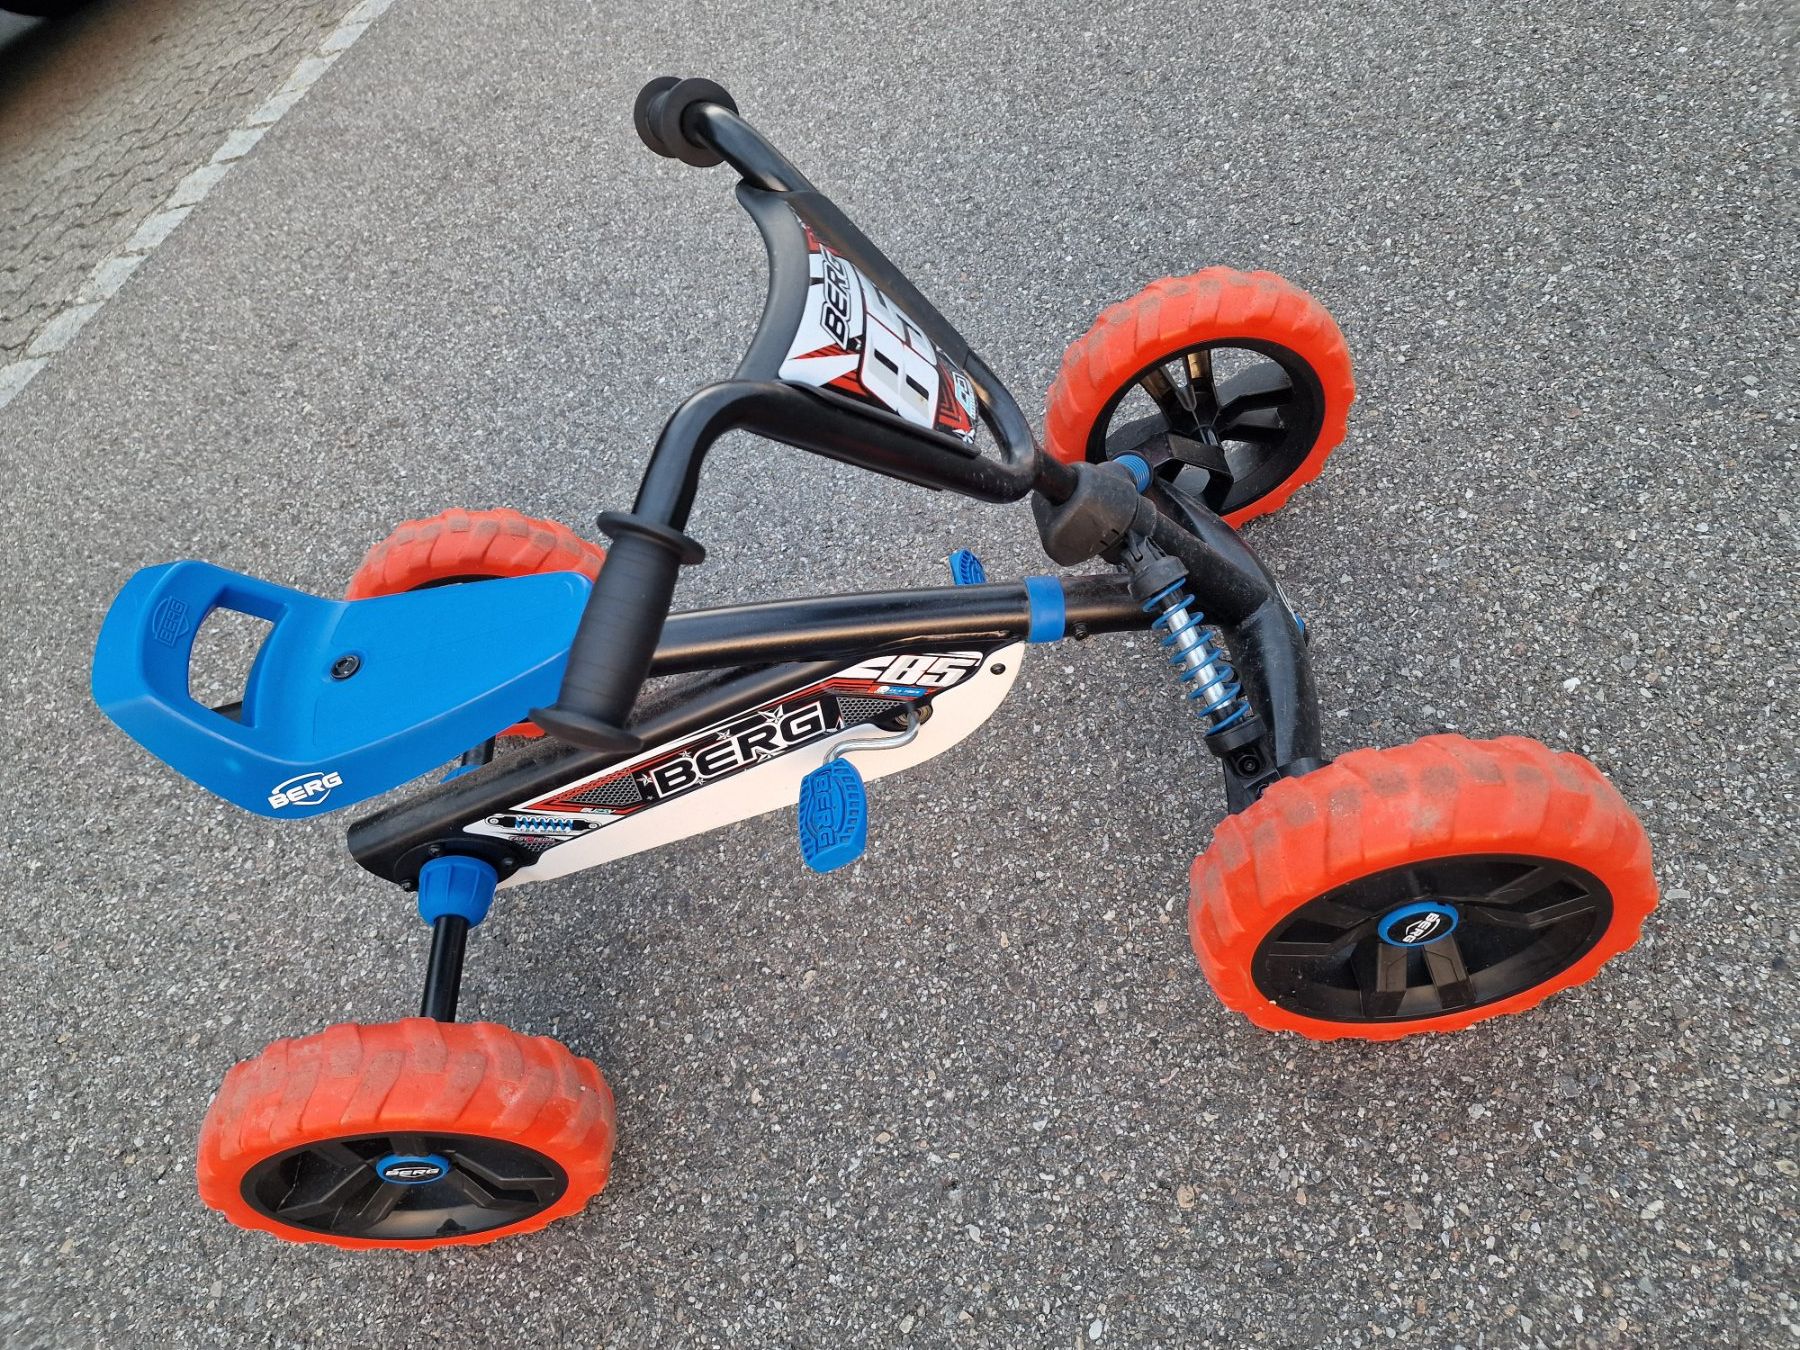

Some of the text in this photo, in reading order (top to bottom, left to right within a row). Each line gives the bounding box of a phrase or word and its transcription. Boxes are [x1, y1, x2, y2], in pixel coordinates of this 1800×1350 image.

[155, 596, 187, 646] BERG
[876, 654, 977, 687] 85
[653, 702, 825, 798] BERG
[268, 771, 343, 810] BERG
[814, 774, 836, 849] BERG
[1402, 912, 1440, 943] BERG
[385, 1167, 440, 1177] BERG
